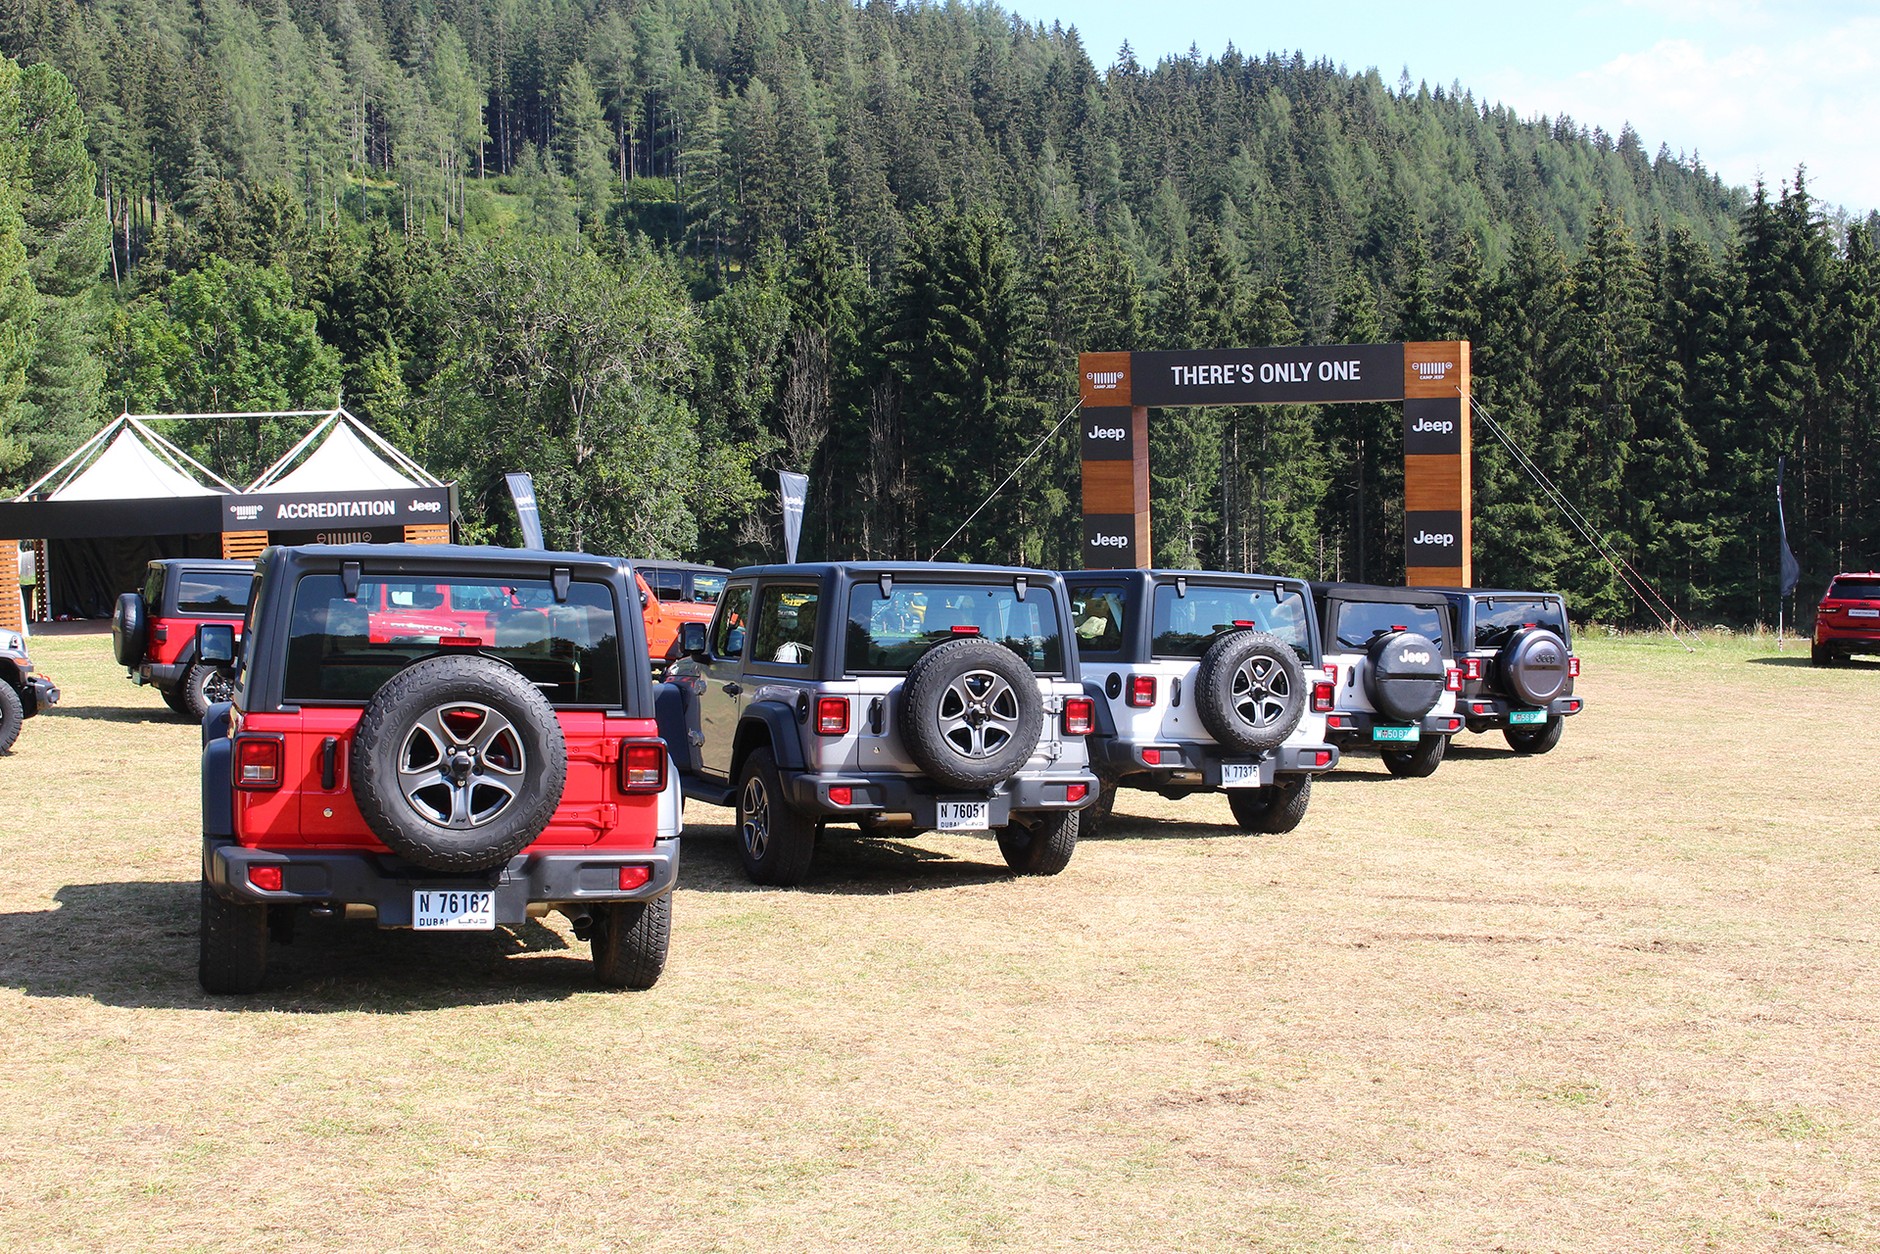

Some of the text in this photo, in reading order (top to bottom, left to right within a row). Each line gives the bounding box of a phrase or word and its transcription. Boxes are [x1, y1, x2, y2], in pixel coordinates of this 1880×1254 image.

[1171, 361, 1361, 386] THERE'S ONLY ONE
[1088, 425, 1126, 441] Jeep
[1412, 418, 1453, 434] Jeep
[277, 500, 396, 519] ACCREDITATION
[408, 500, 441, 513] Jeep
[1090, 533, 1128, 548] Jeep
[1413, 531, 1454, 547] Jeep
[1399, 649, 1430, 665] Jeep
[1535, 654, 1556, 664] Jeep
[1224, 766, 1258, 778] N 77375
[940, 804, 985, 818] N 76051
[419, 893, 490, 914] N 76162
[419, 918, 449, 927] DUBAI
